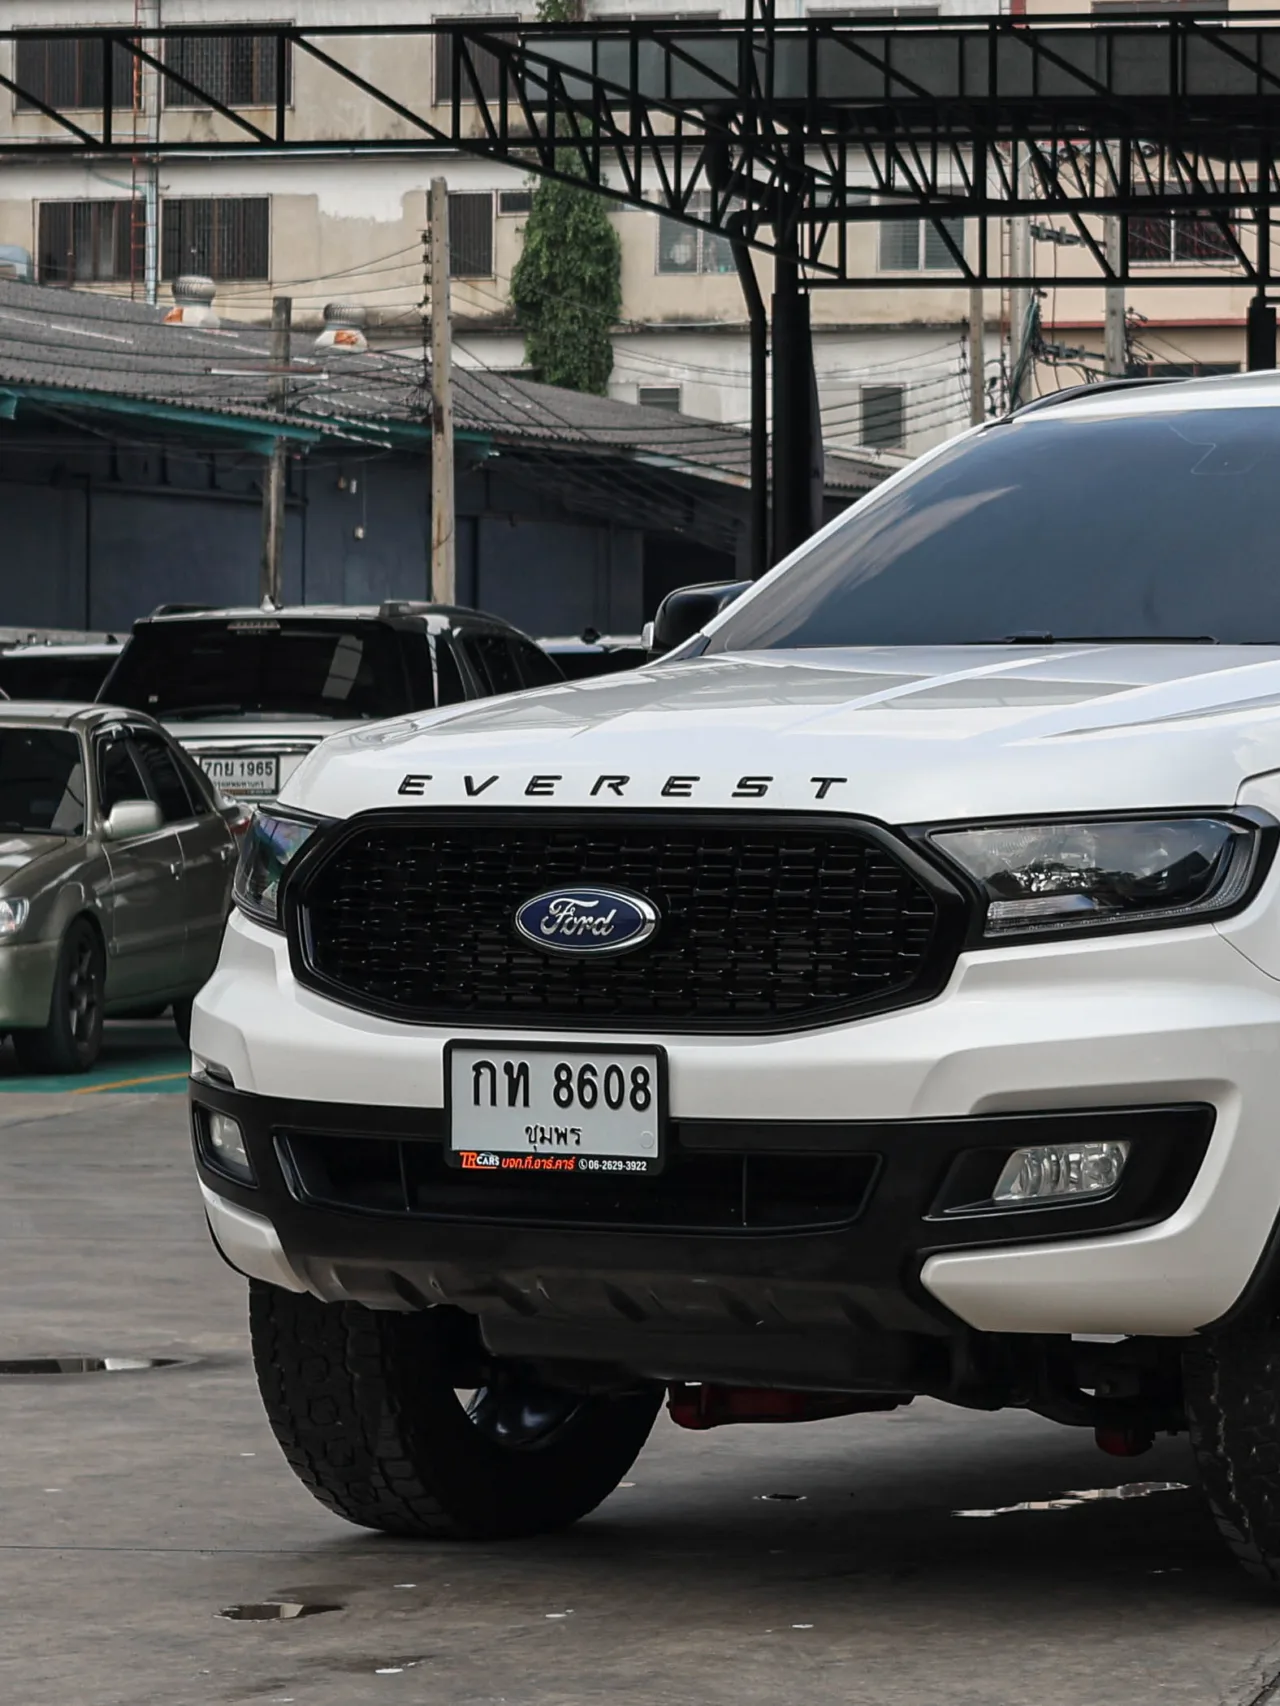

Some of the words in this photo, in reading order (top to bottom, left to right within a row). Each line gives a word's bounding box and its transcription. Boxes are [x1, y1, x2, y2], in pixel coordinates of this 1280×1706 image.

[240, 761, 274, 777] 1965
[397, 774, 848, 800] EVEREST
[539, 898, 615, 937] Ford
[472, 1060, 530, 1108] กท
[553, 1063, 652, 1112] 8608
[525, 1125, 582, 1152] ชุมพร
[588, 1159, 647, 1172] 06-2629-3922
